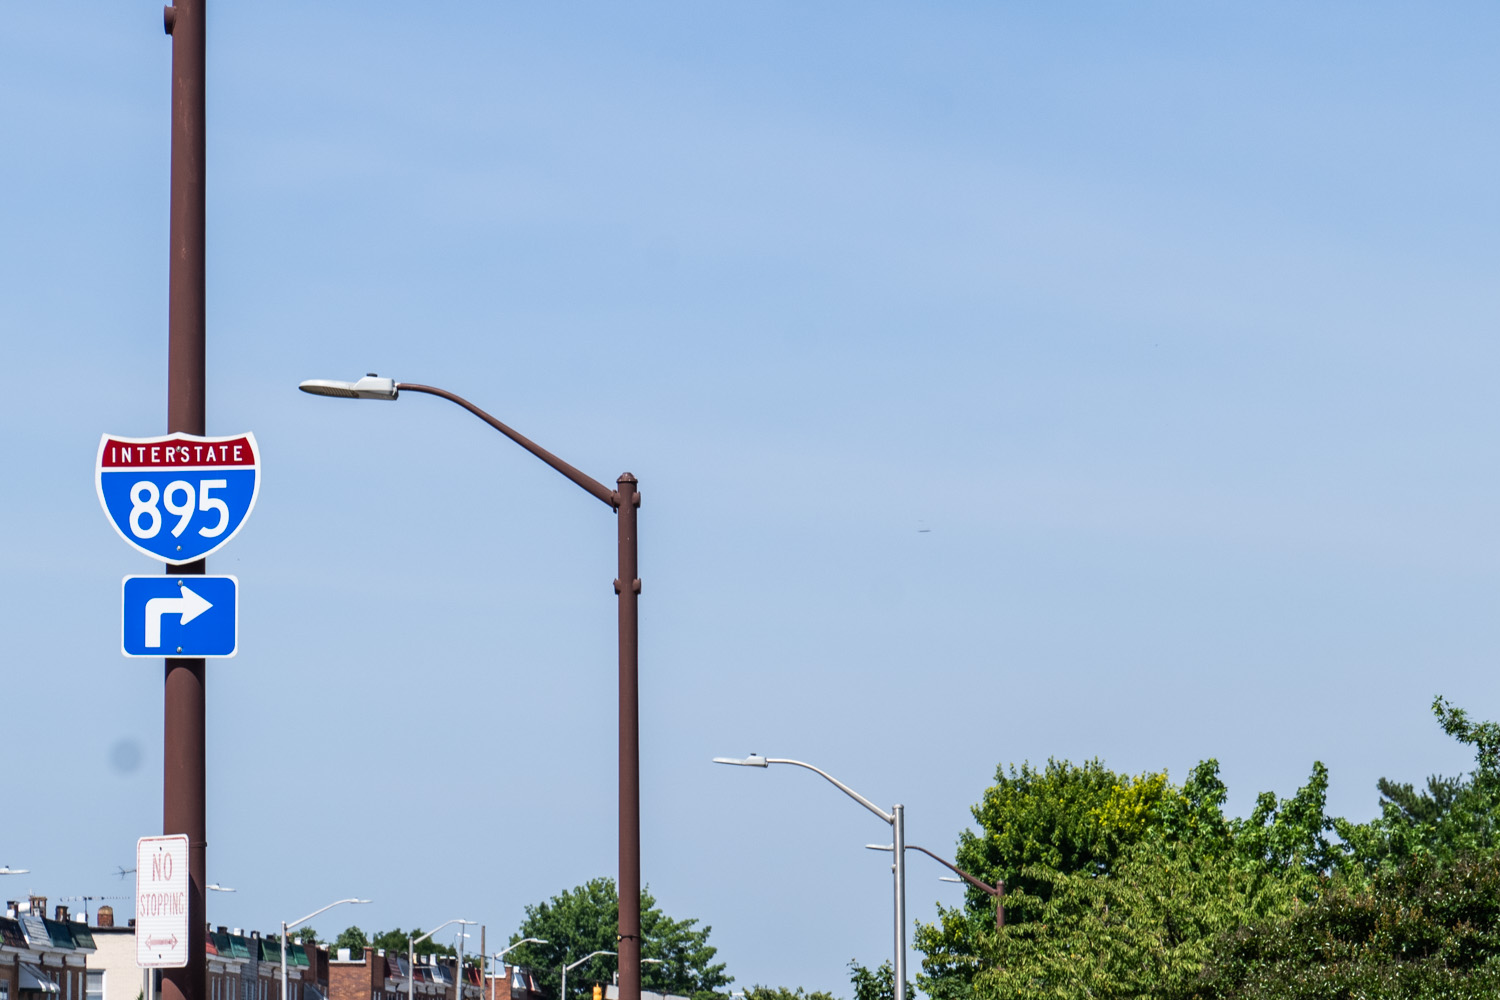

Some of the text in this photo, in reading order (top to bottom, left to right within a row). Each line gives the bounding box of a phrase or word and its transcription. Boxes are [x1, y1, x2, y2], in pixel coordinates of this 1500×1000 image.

[111, 445, 243, 463] INTERSTATE
[128, 479, 230, 539] 895
[152, 852, 173, 881] NO
[140, 892, 184, 917] STOPPING
